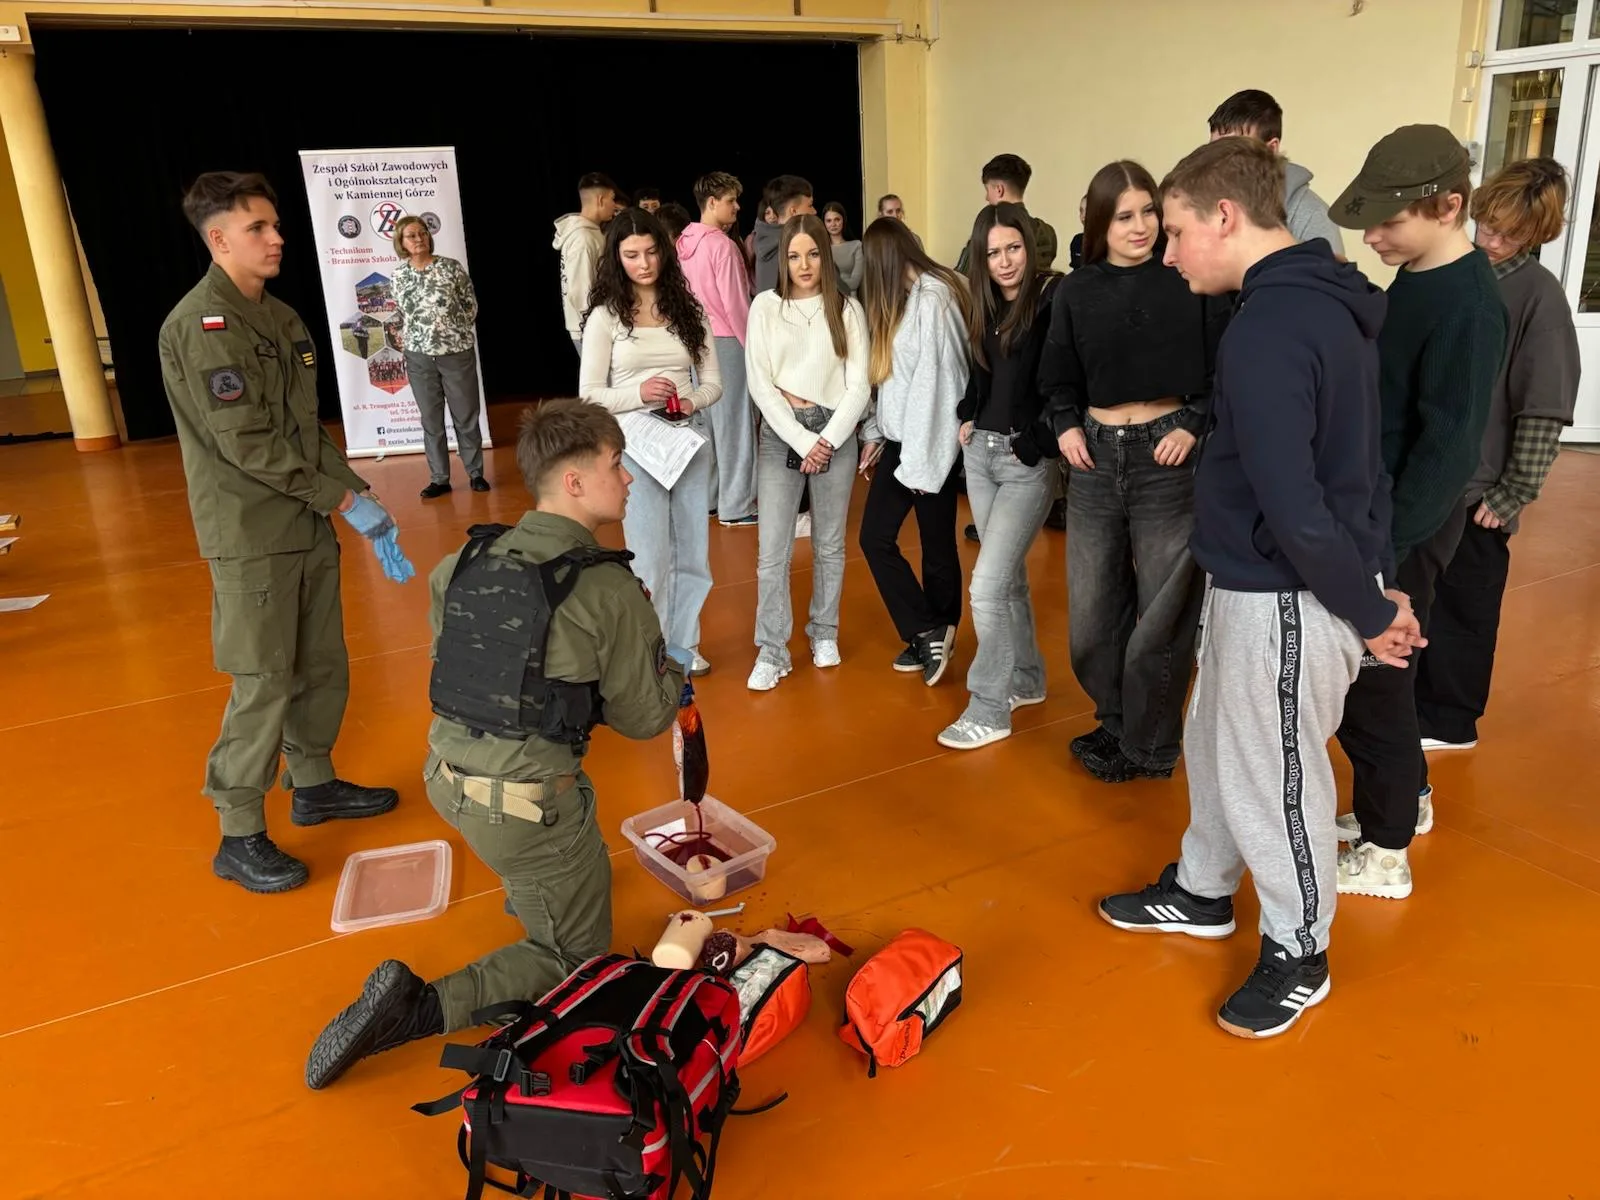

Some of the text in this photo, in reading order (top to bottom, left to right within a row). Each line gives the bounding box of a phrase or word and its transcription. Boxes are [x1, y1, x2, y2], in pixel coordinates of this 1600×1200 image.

[313, 161, 448, 175] Zespół Szkół Zawodowych
[334, 174, 437, 189] Ogólnokształcących
[346, 190, 403, 200] Kamiennej
[405, 188, 435, 198] Górze
[330, 247, 374, 255] Technikum
[332, 256, 371, 265] Branżowa
[371, 255, 397, 263] Szkoła
[1283, 630, 1298, 678] Kappa
[1287, 752, 1299, 792] Kappa
[1290, 809, 1304, 850] Kappa
